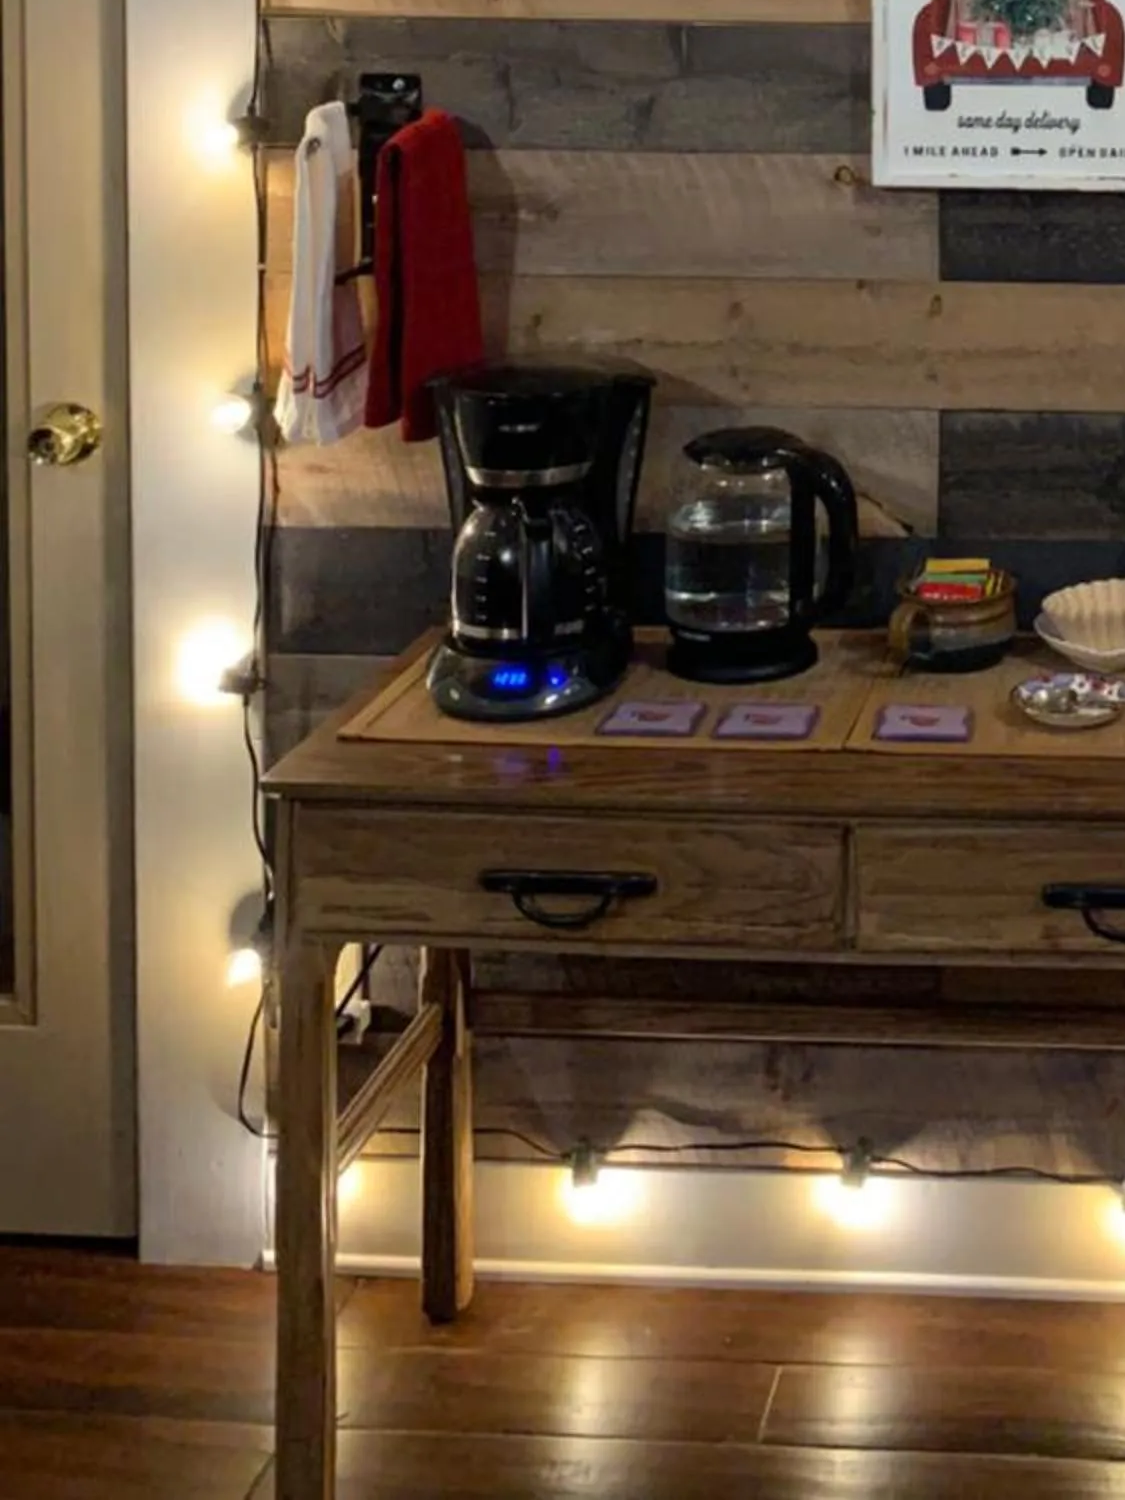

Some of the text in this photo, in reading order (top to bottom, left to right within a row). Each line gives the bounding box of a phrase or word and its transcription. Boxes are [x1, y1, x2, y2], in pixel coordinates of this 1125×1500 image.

[957, 110, 1081, 135] same day delivery
[912, 146, 946, 157] MILE
[950, 146, 999, 158] AHEAD
[1058, 146, 1096, 158] OPEN
